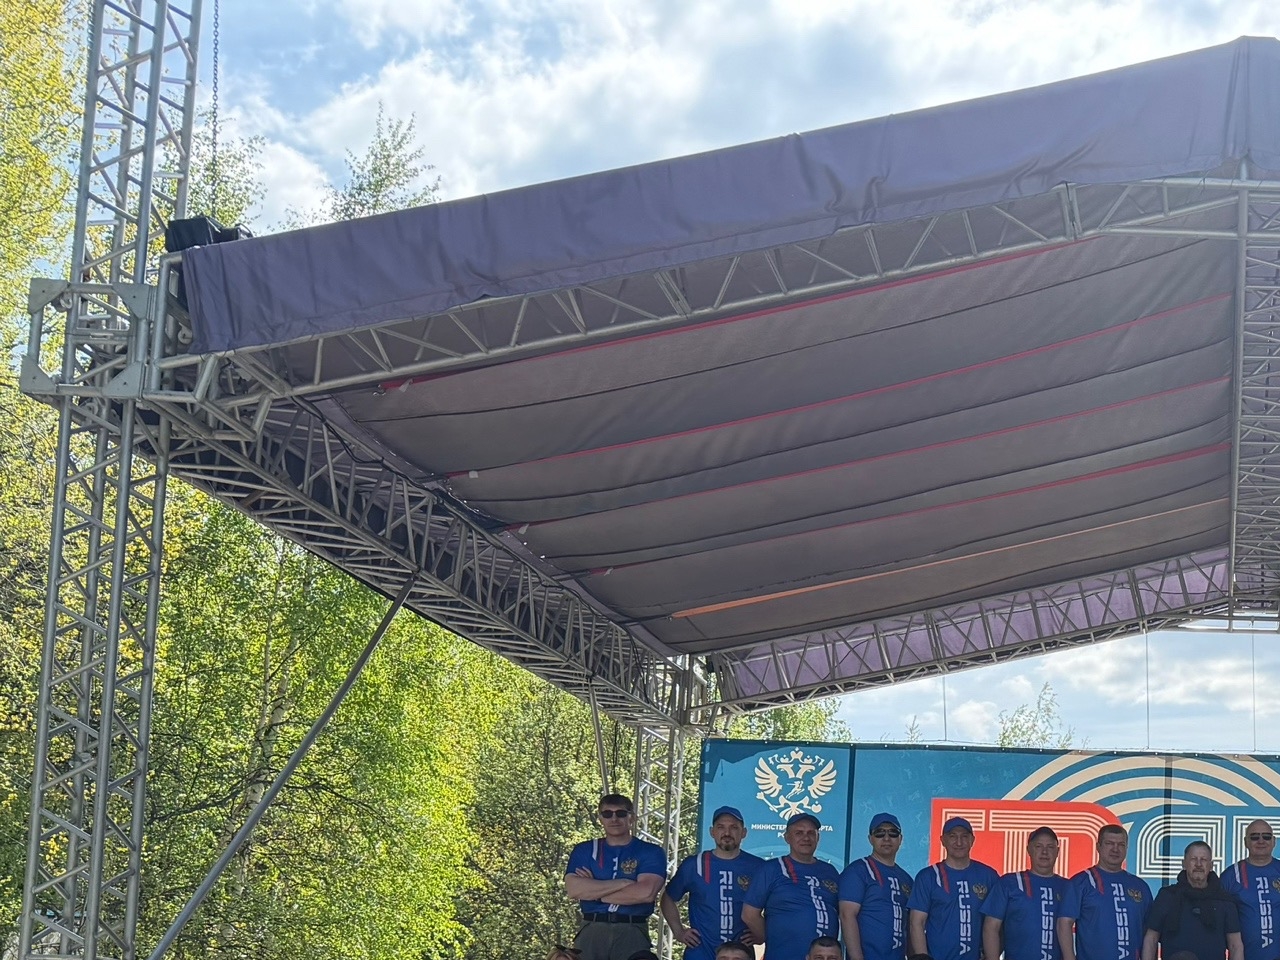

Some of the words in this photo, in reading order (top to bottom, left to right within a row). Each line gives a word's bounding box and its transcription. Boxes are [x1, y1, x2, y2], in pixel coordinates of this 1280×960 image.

[888, 876, 905, 950] RUSSIA
[956, 880, 973, 955] RUSSIA
[1110, 882, 1129, 960] RUSSIA
[1255, 876, 1274, 949] RUSSIA
